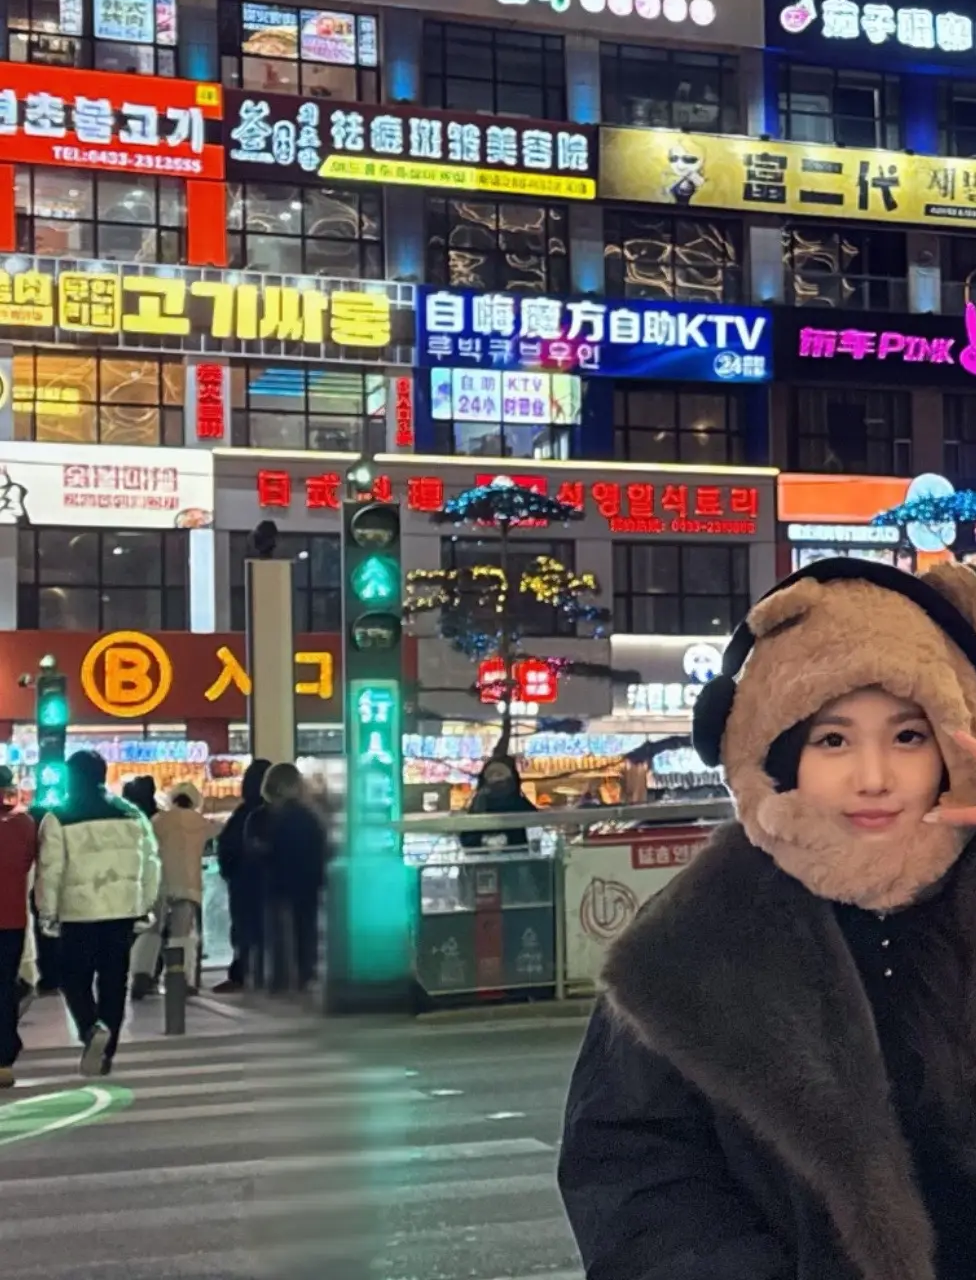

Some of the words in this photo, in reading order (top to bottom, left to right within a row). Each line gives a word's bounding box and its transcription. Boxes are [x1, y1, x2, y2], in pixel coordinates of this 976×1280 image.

[743, 152, 900, 212] 富二代
[508, 378, 543, 392] KTV
[105, 647, 152, 703] B
